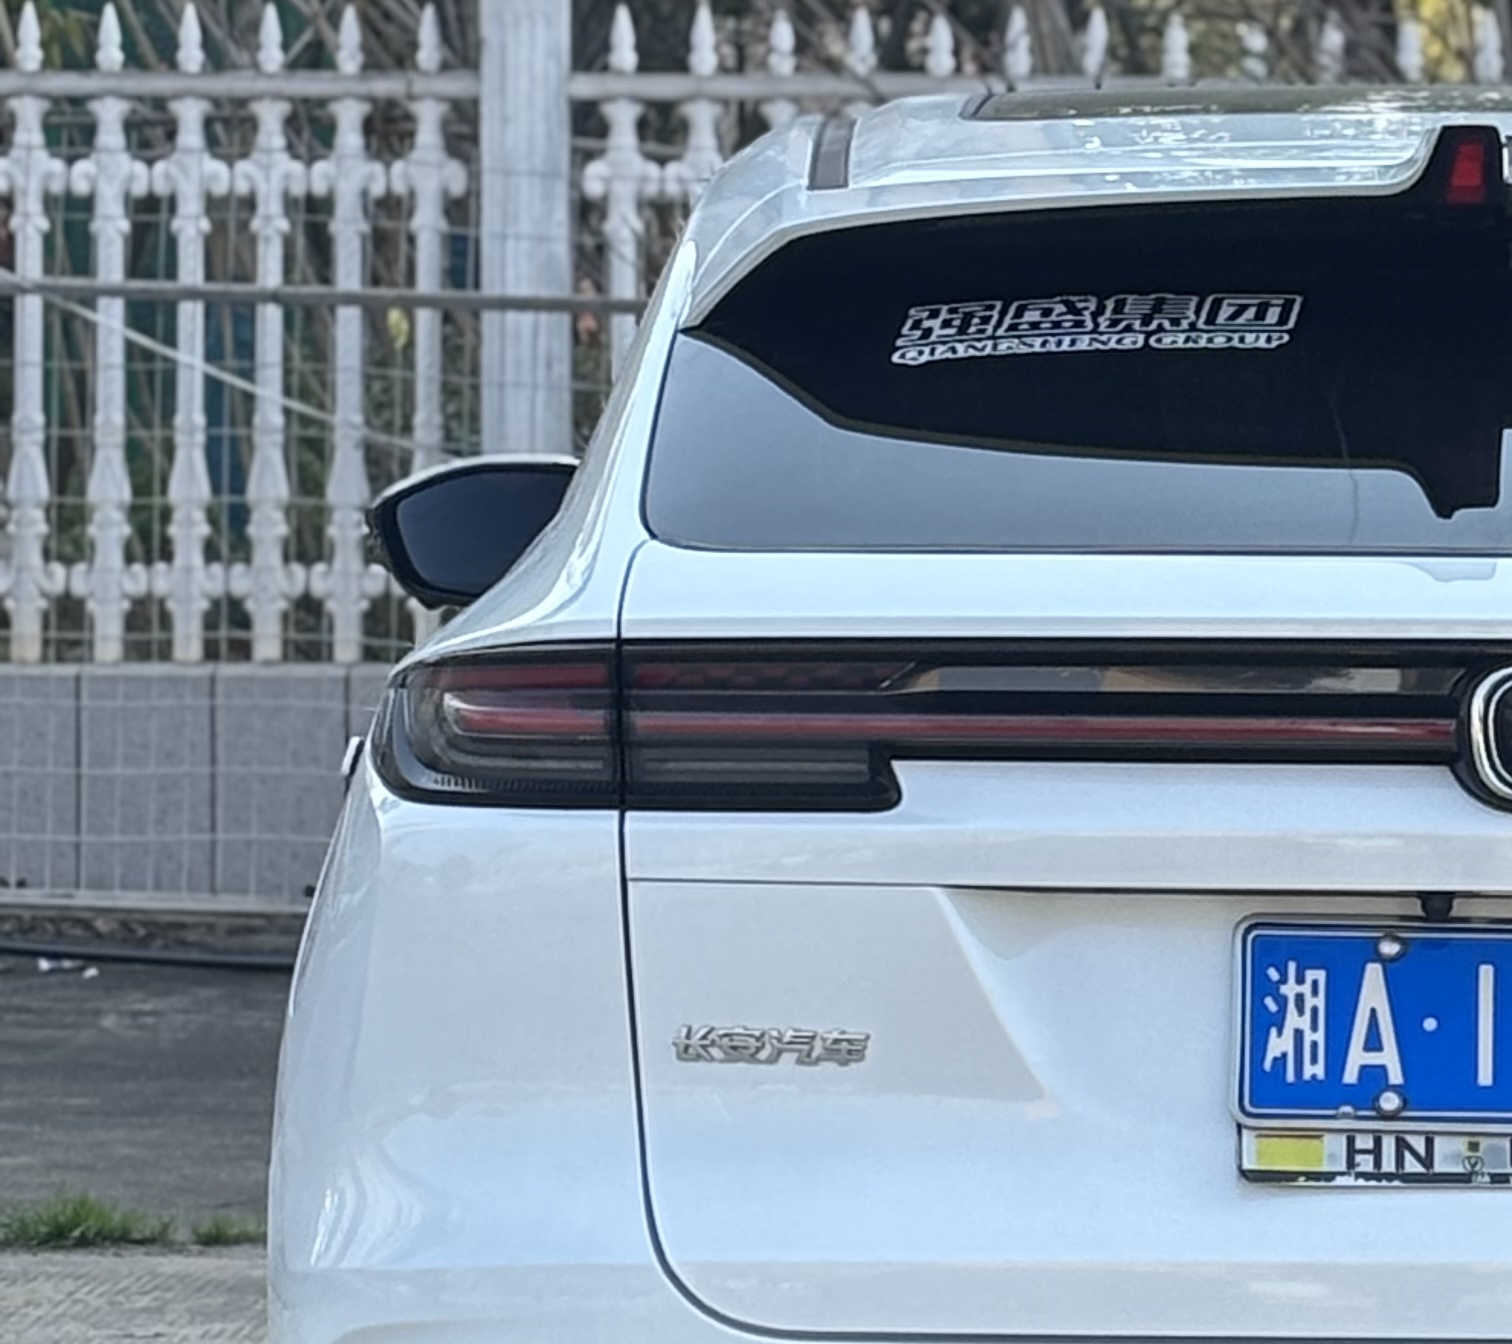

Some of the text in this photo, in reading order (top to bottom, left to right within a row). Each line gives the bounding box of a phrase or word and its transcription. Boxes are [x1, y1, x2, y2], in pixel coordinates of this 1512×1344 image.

[896, 294, 1303, 346] 强盛集团
[891, 332, 1290, 365] QIANGSHENG GROUP
[672, 1024, 870, 1066] 长安汽车
